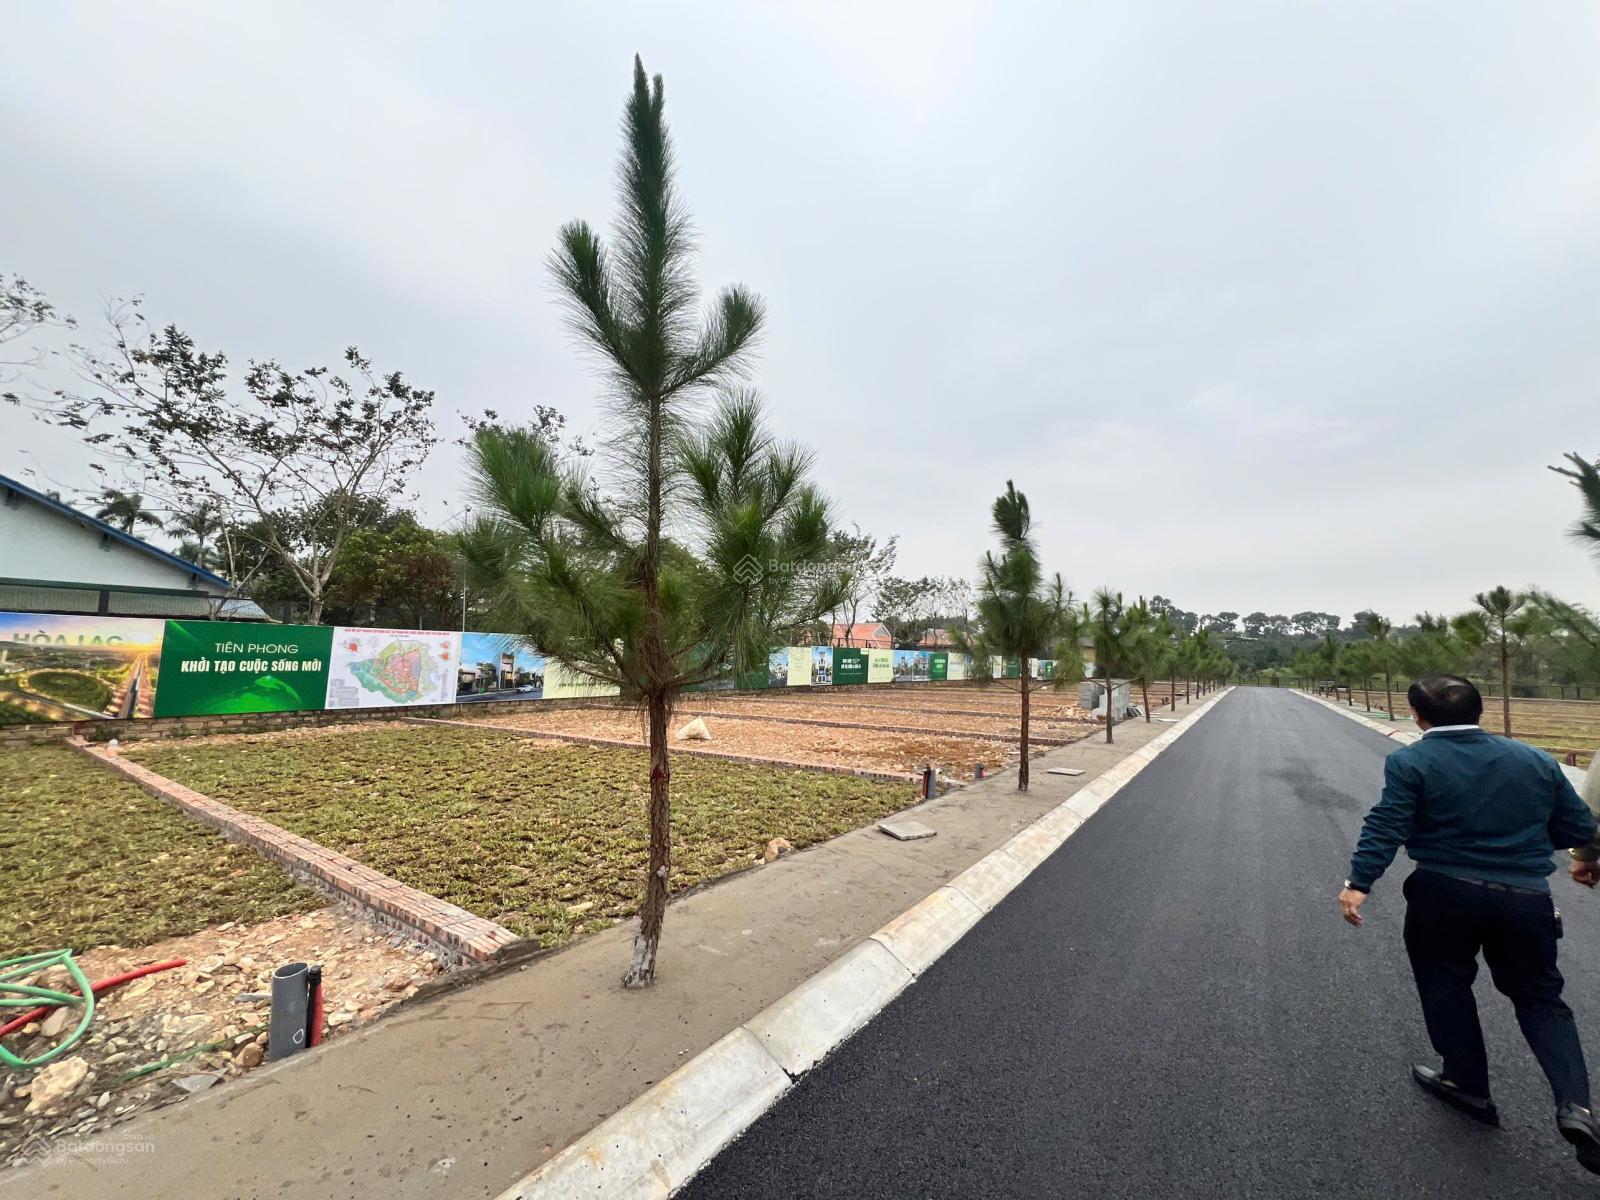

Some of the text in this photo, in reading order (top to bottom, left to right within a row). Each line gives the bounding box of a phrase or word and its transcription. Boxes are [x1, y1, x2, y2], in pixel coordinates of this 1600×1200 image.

[215, 641, 299, 654] TIÊN PHONG
[181, 657, 210, 673] KHỞI
[214, 660, 236, 675] TẠO
[239, 658, 268, 674] CUỘC
[272, 657, 299, 672] SỐNG
